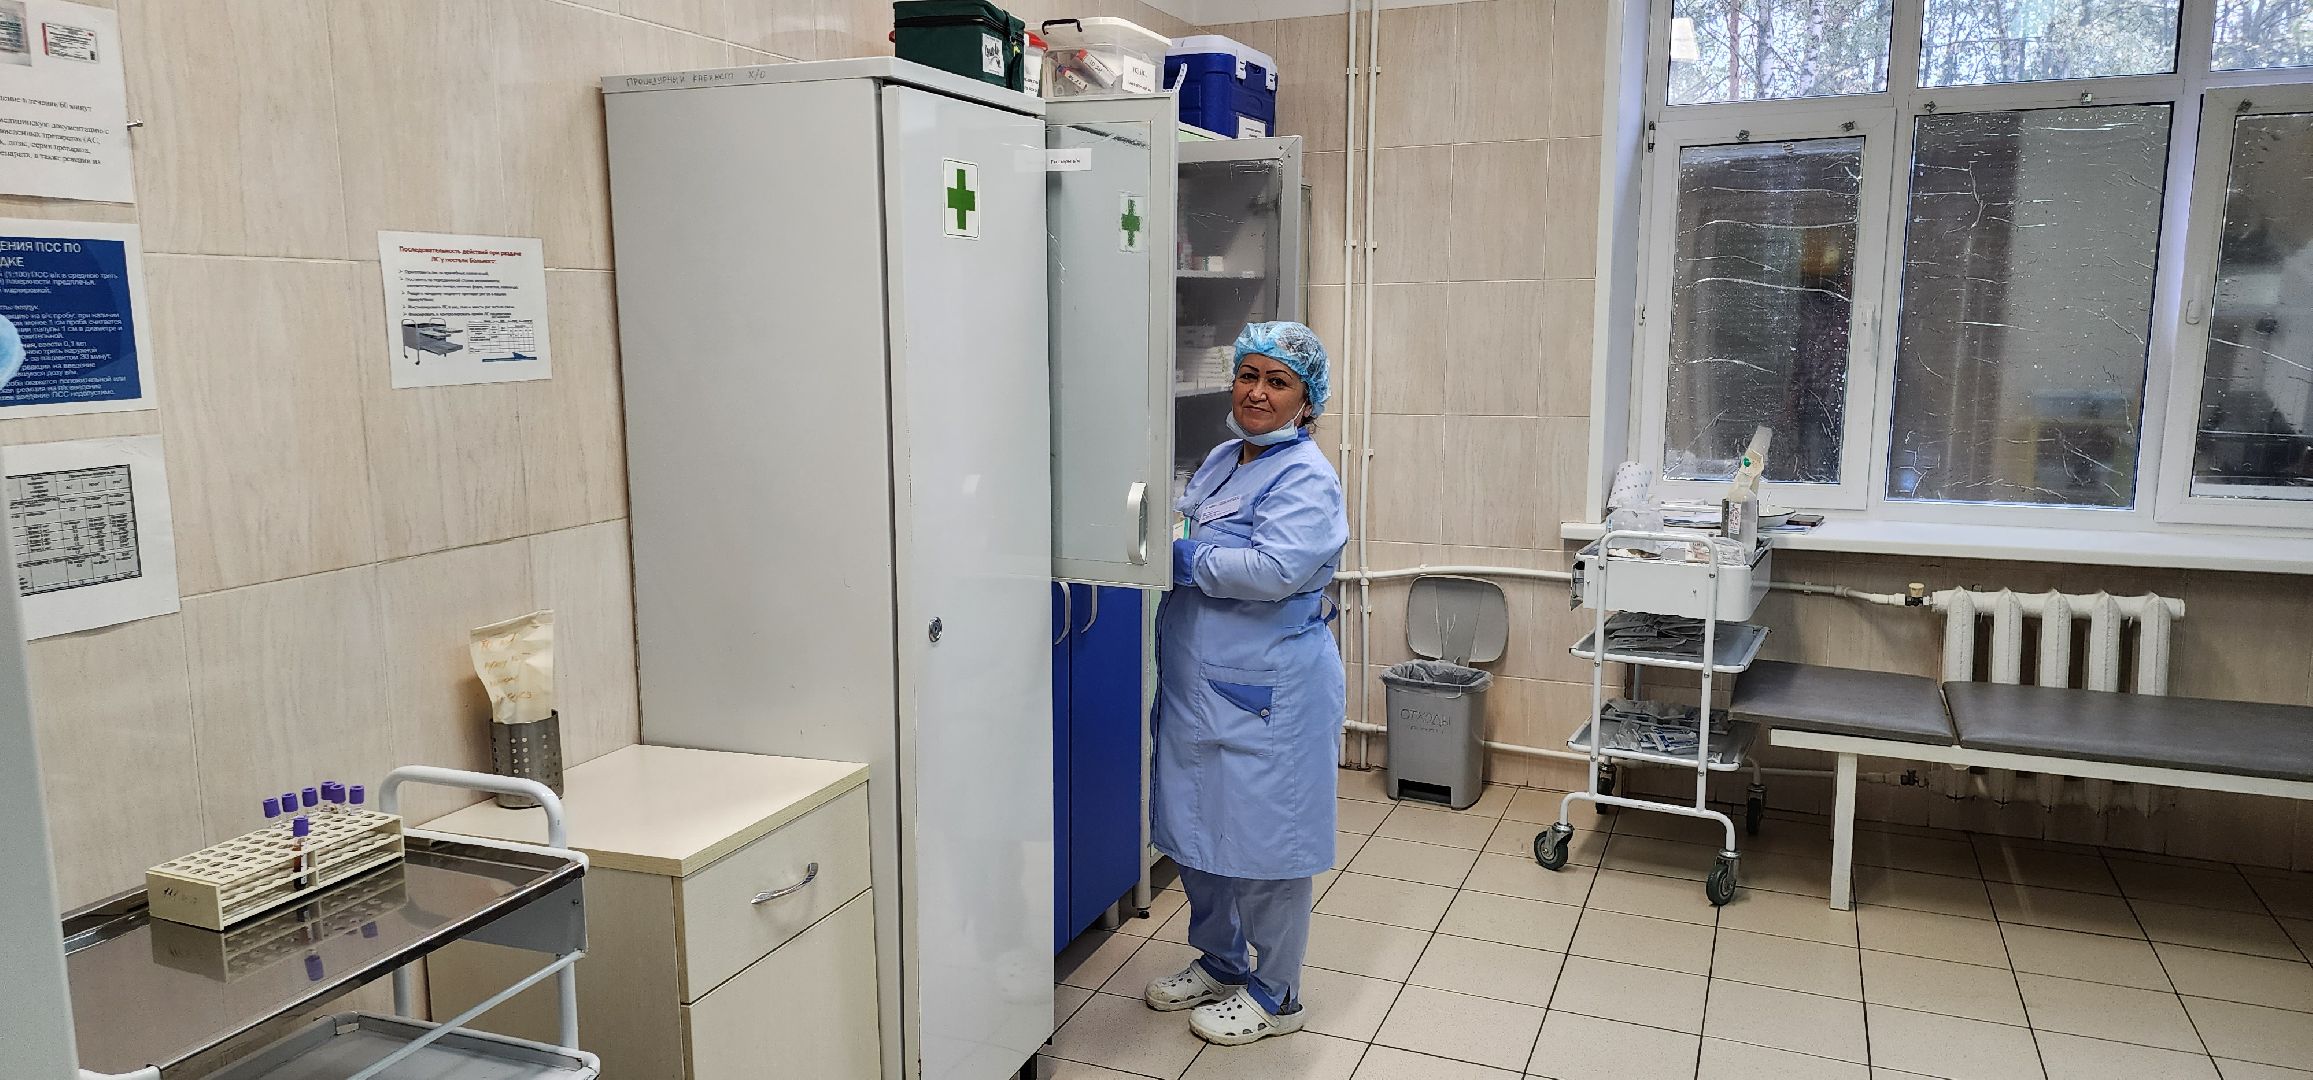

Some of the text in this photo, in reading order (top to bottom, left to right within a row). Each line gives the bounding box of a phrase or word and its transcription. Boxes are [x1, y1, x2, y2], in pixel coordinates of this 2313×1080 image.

[0, 241, 82, 253] ЕНИЯ ПСС ПО
[399, 246, 462, 255] Последовательность
[1400, 708, 1451, 727] ОТХОДЫ
